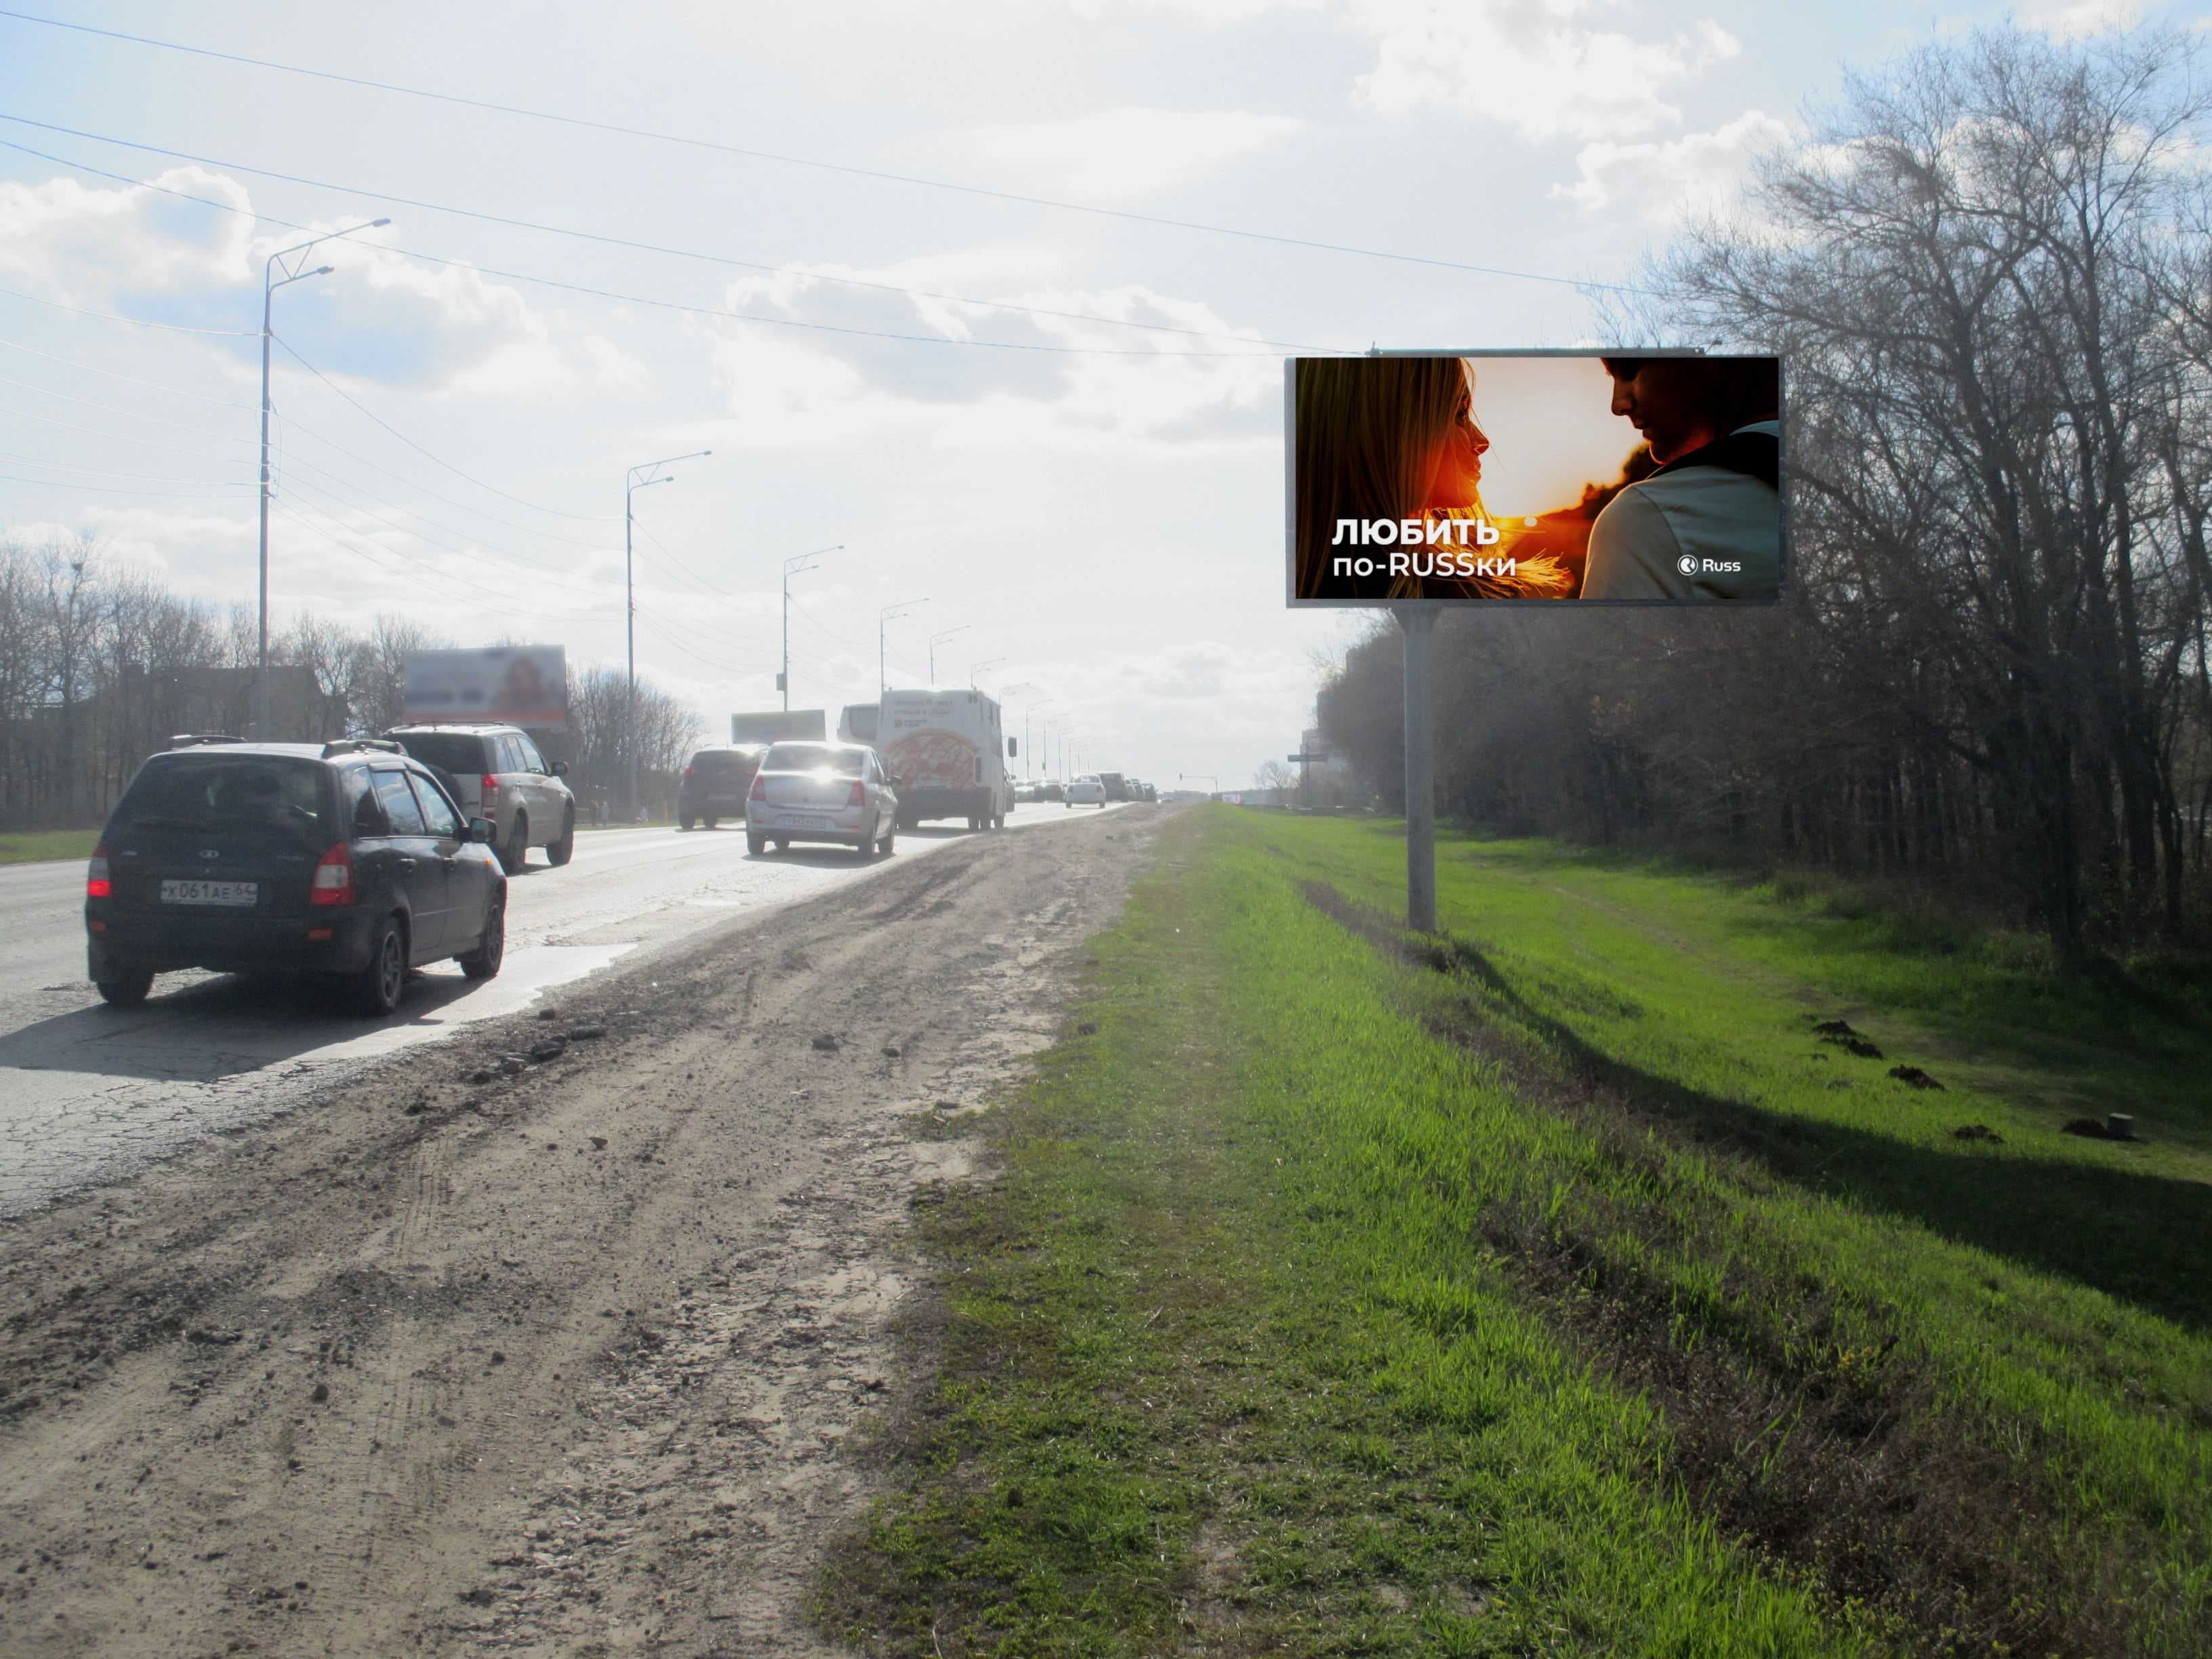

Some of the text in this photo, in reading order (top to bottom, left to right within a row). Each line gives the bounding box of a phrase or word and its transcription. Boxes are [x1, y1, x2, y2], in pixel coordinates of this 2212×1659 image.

[1332, 518, 1500, 545] ЛЮБИТЬ
[1334, 552, 1516, 576] по-RUSSки
[1702, 558, 1741, 572] Russ
